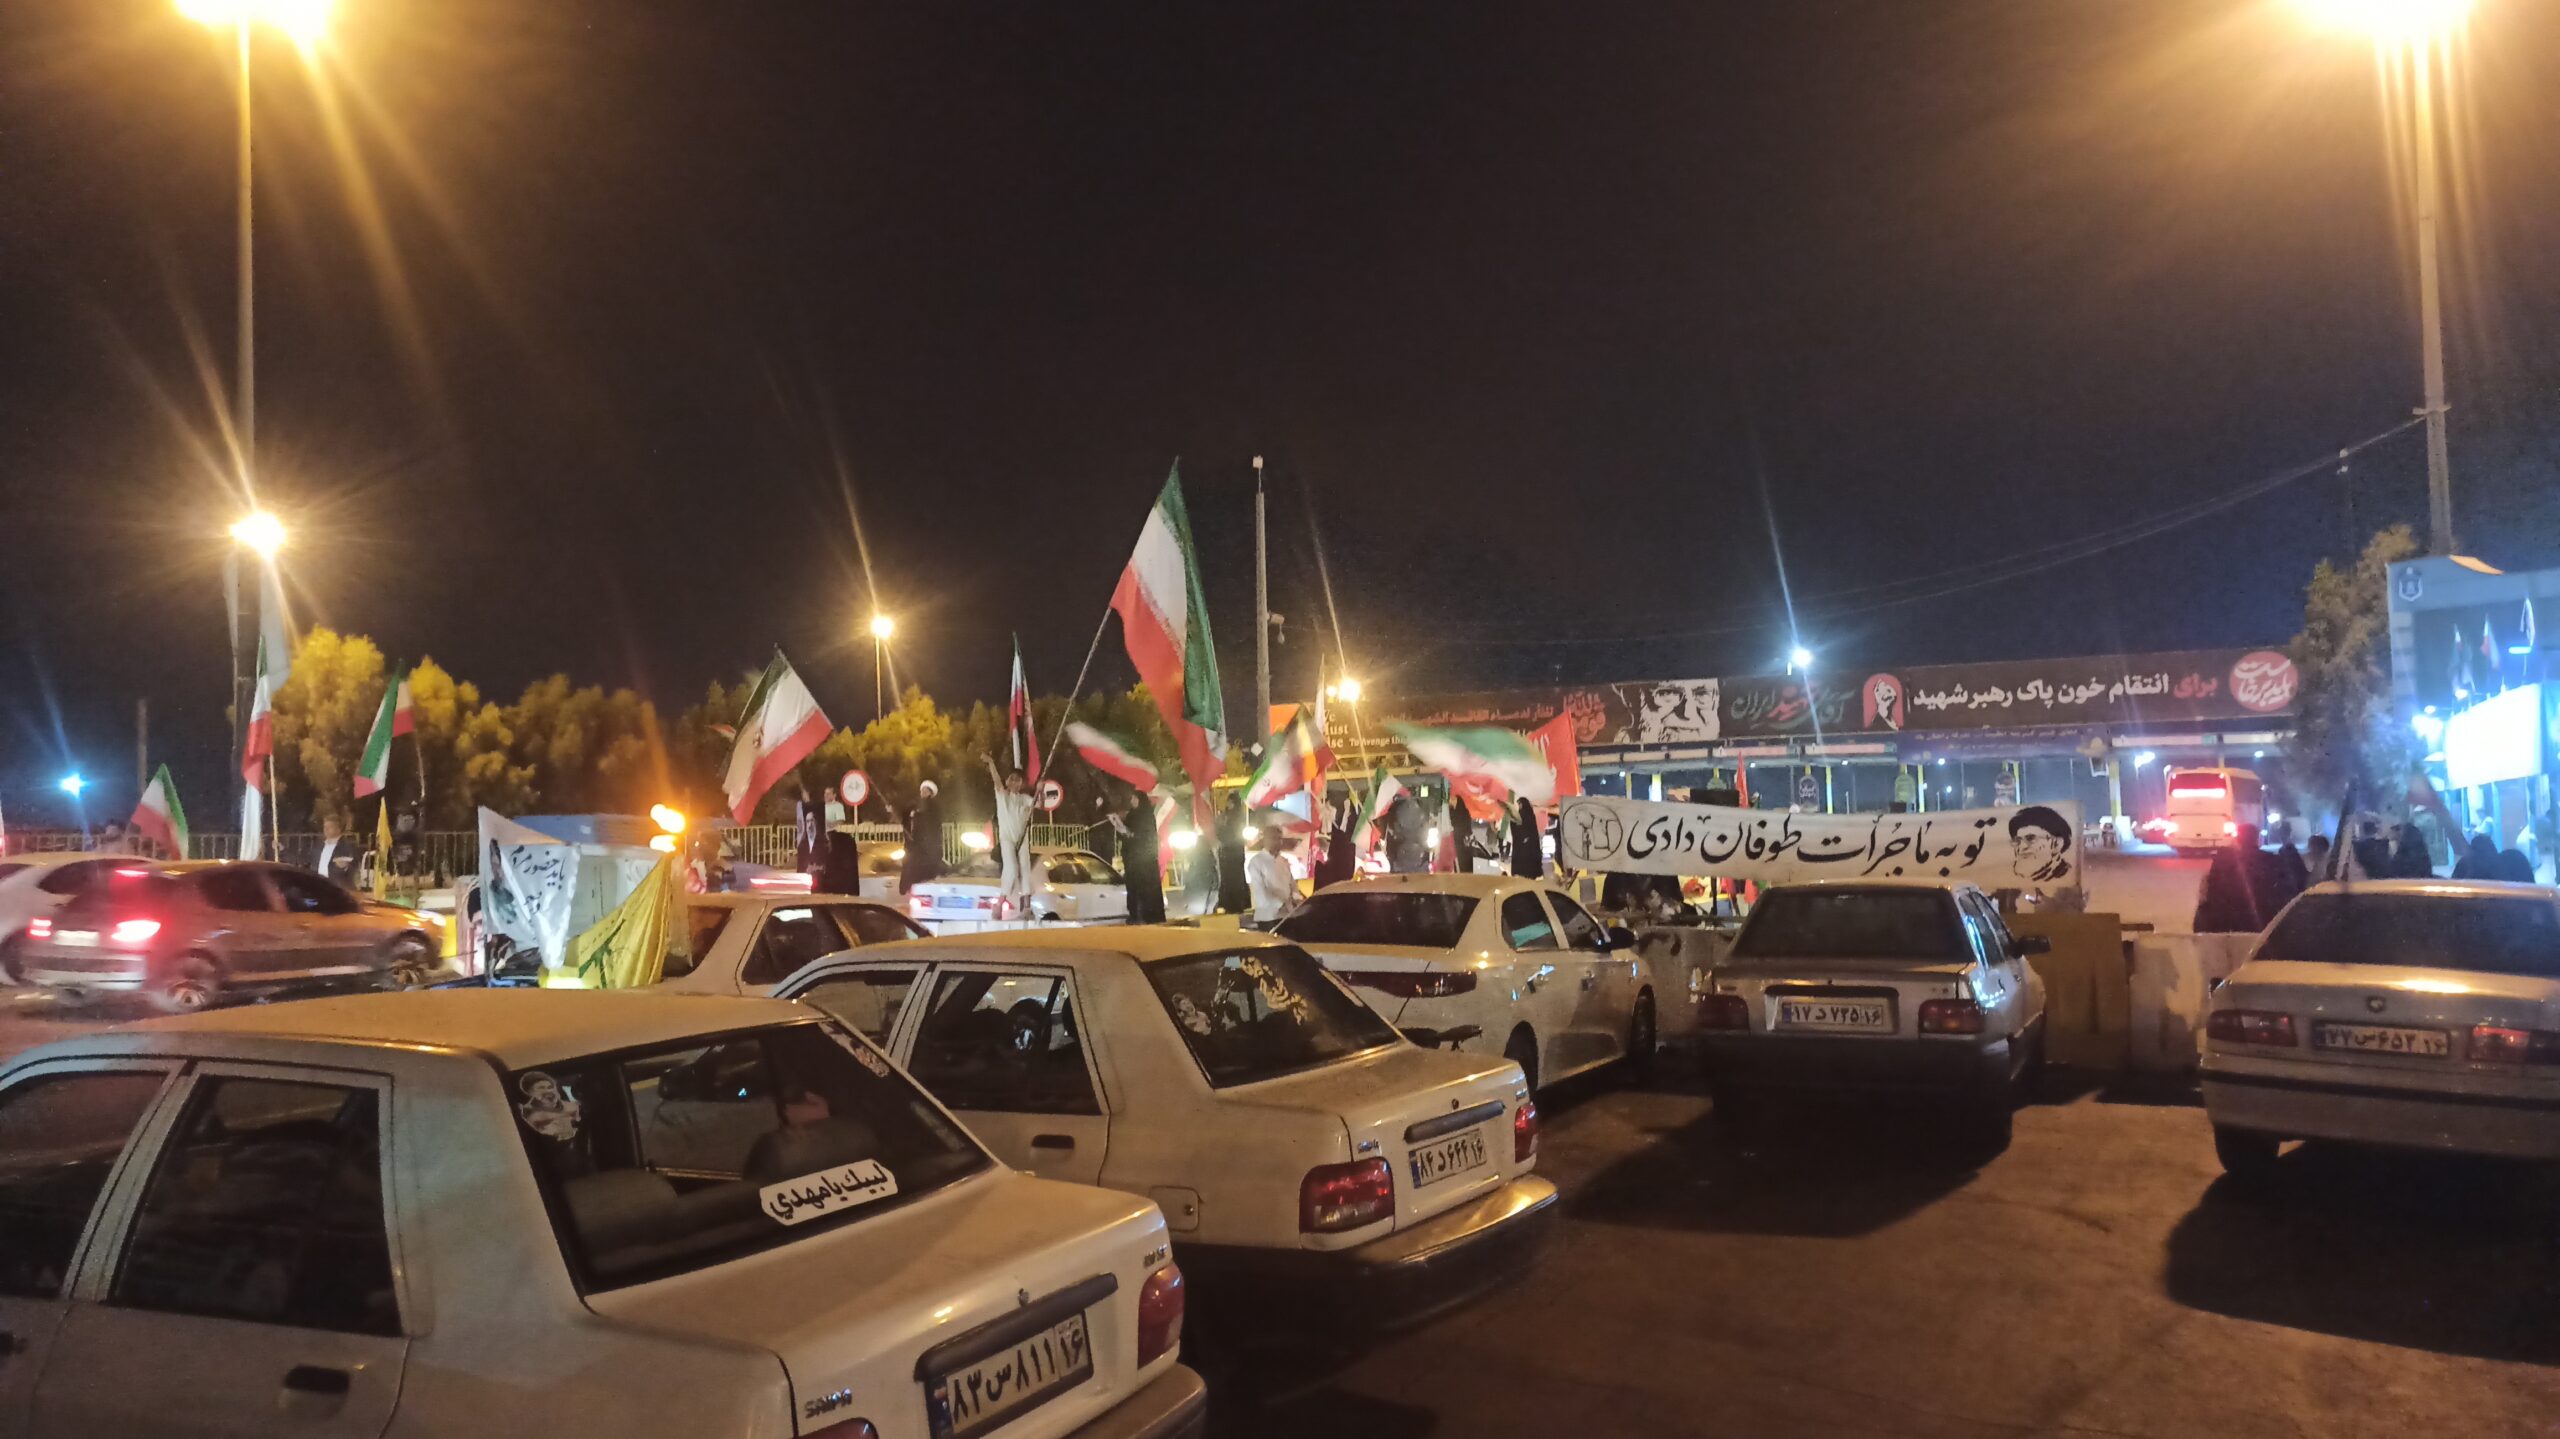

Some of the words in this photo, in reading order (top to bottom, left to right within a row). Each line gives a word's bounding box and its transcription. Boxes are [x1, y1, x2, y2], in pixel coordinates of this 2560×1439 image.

[1913, 683, 1968, 711] شهید
[1967, 685, 2013, 710] رهبر
[2017, 679, 2054, 709] پاک
[2058, 676, 2105, 704] خون
[2109, 672, 2169, 704] انتقام
[2174, 673, 2218, 698] برای
[1627, 815, 1695, 860] دادی
[1700, 812, 1803, 865] طوفان
[1960, 816, 1997, 869] تو
[1935, 842, 1957, 877] به
